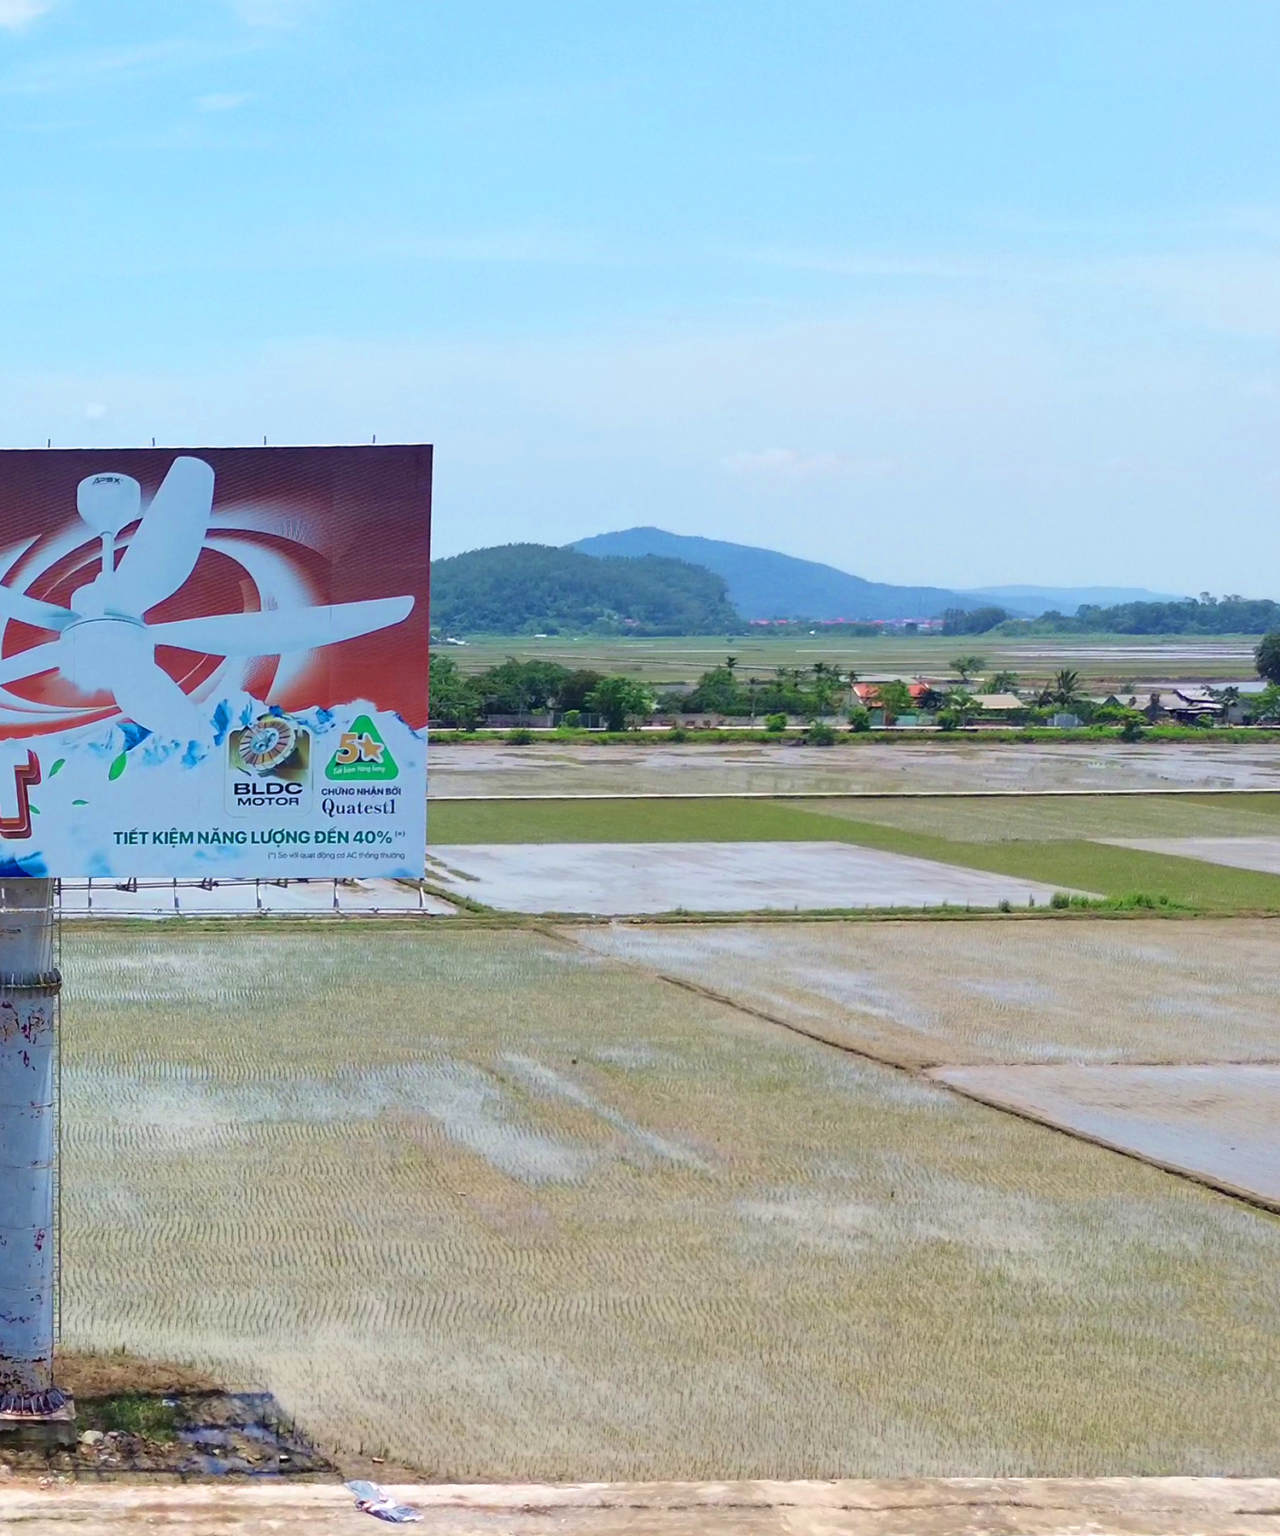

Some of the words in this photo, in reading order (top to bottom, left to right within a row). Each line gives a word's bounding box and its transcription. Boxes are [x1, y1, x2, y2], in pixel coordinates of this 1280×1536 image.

[234, 782, 303, 795] BLDC
[321, 786, 355, 796] CHỨNG
[357, 786, 384, 797] NHẬN
[238, 797, 299, 806] MOTOR
[113, 827, 149, 845] TIẾT
[152, 827, 194, 848] KIỆM
[197, 827, 248, 845] NĂNG
[251, 828, 311, 848] LƯỢNG
[314, 826, 349, 844] ĐẾN
[353, 830, 393, 844] 40%
